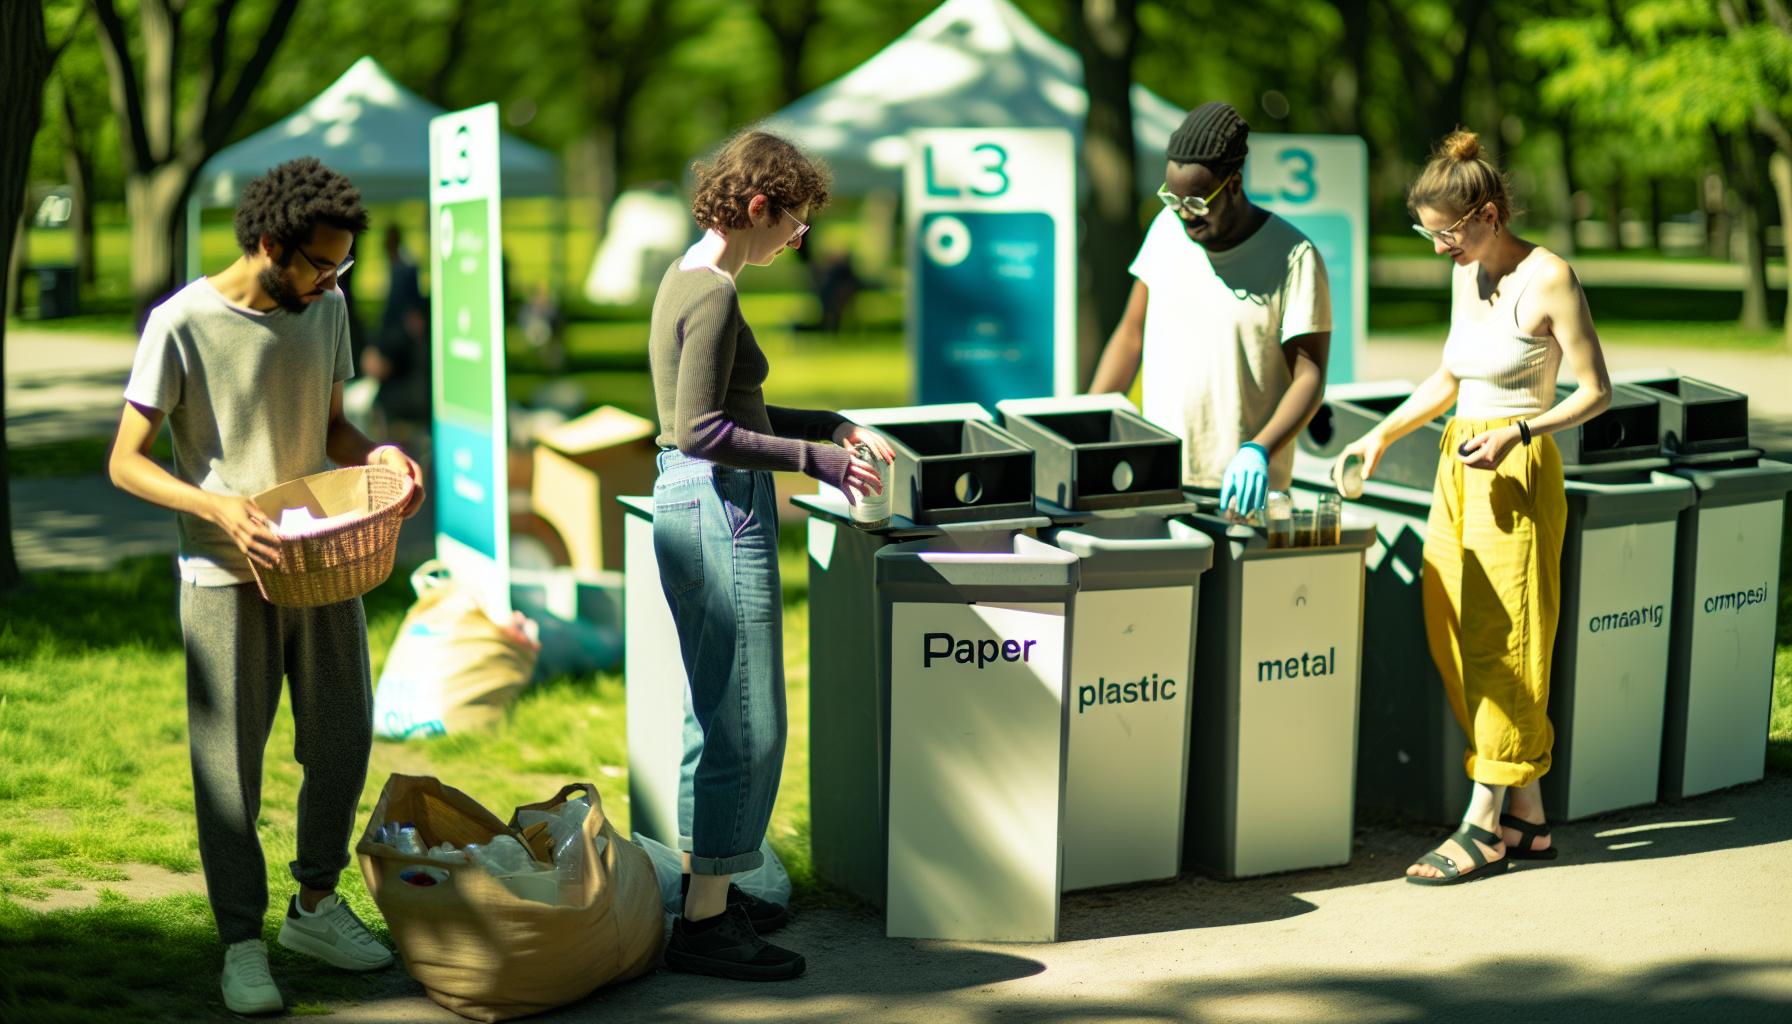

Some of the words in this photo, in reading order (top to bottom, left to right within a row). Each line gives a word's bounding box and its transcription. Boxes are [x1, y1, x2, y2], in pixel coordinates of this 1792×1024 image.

[925, 143, 1009, 197] L3
[924, 632, 1037, 669] Paper
[1258, 646, 1335, 682] metal
[1079, 673, 1177, 714] plastic
